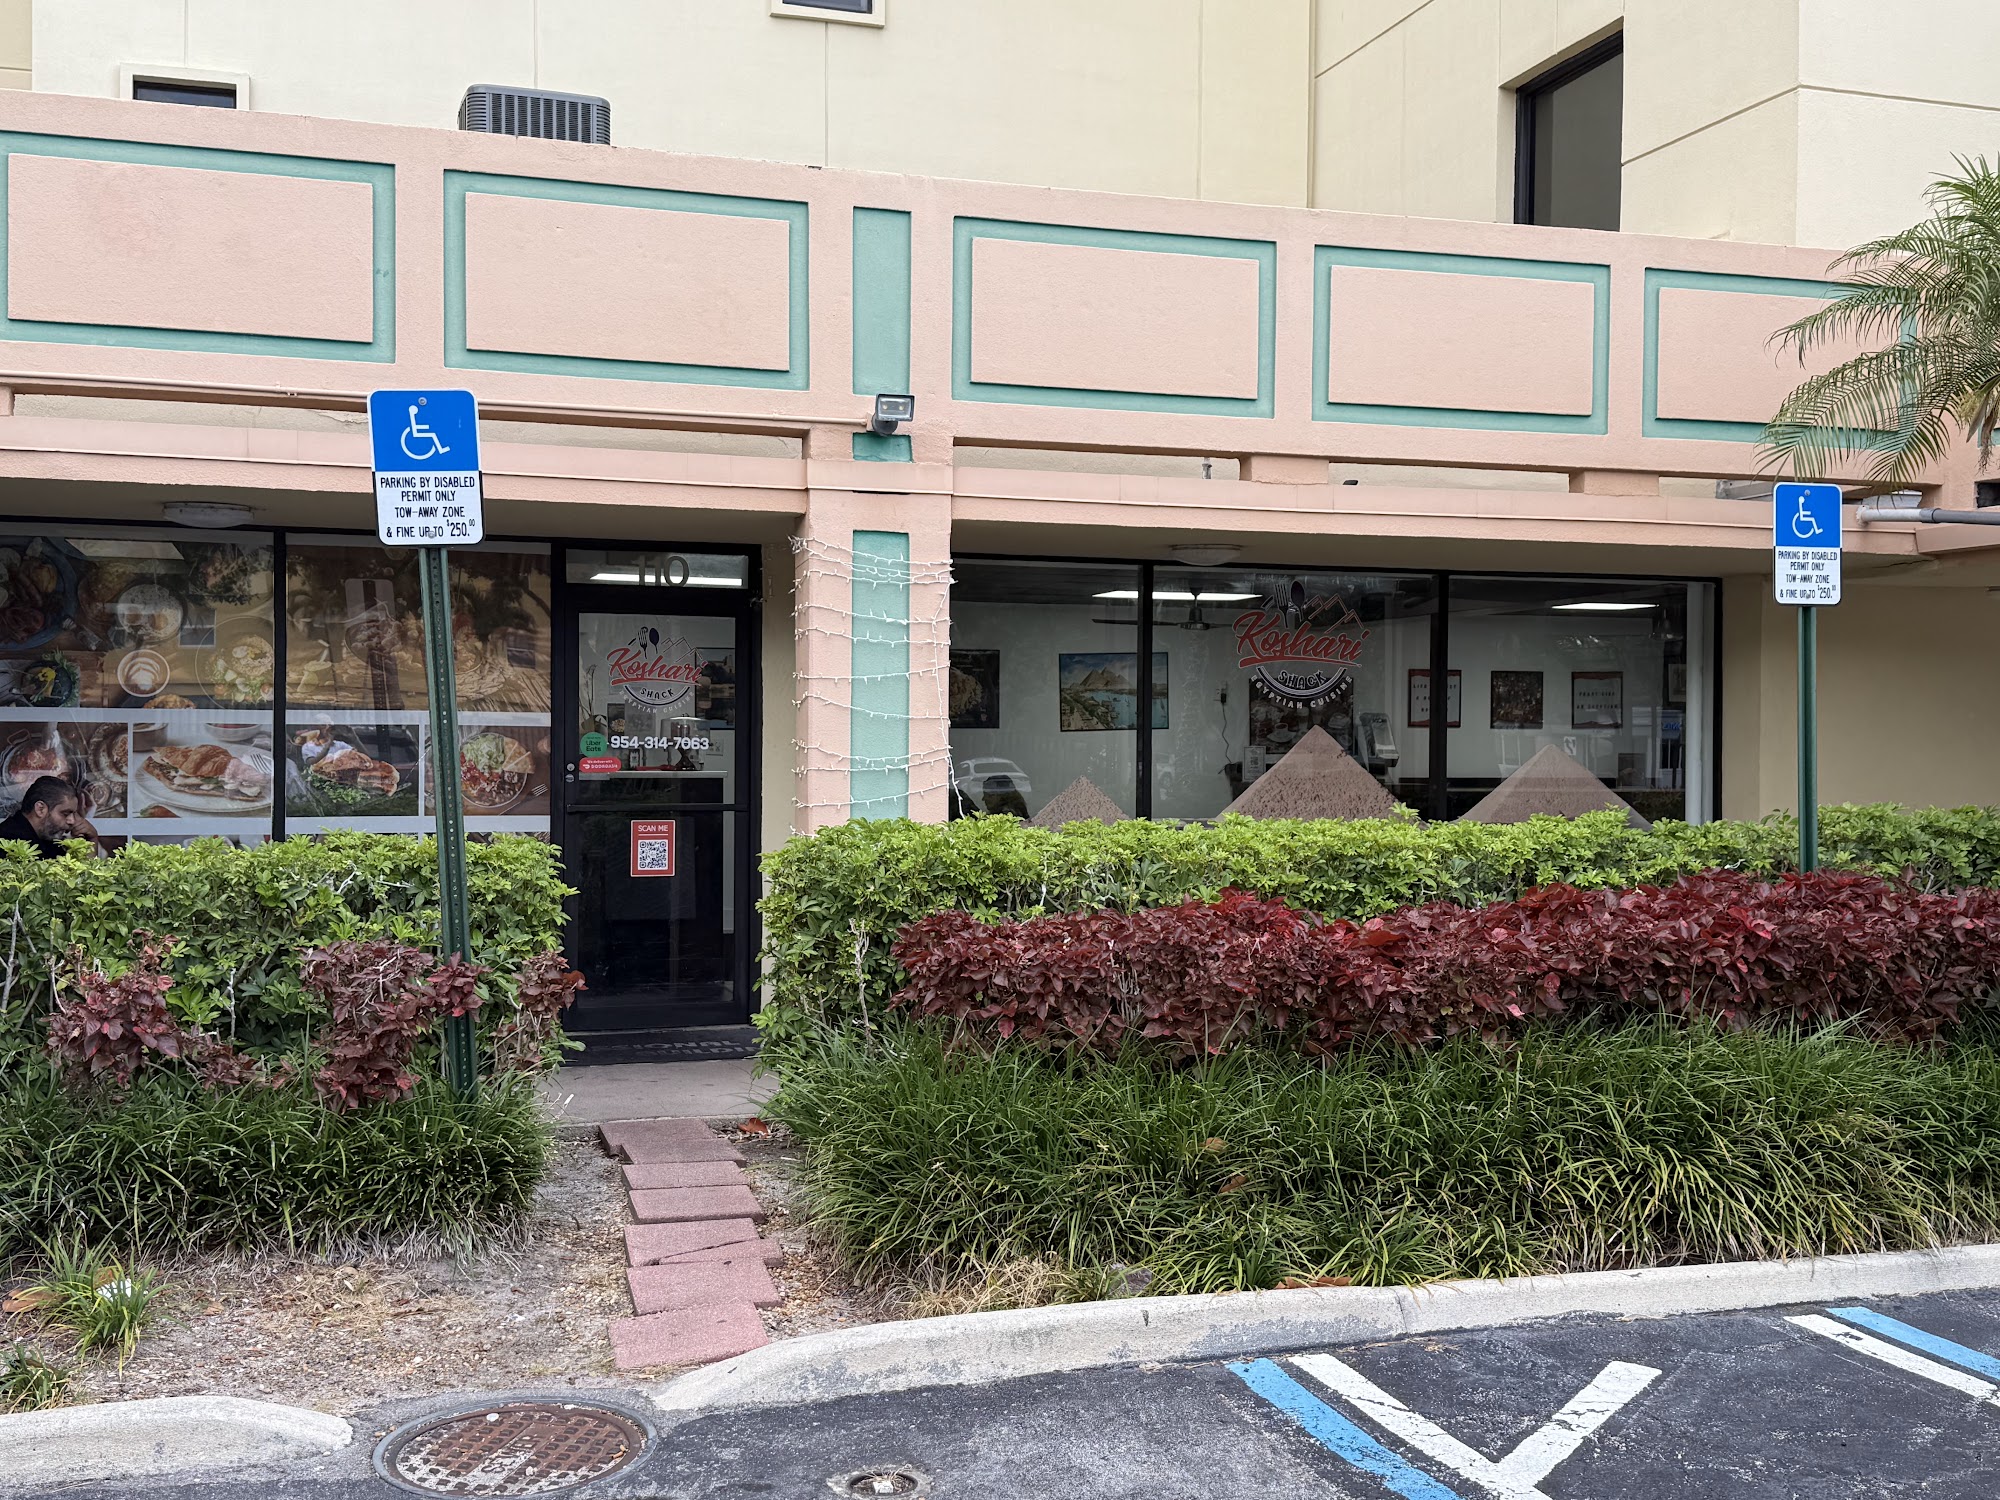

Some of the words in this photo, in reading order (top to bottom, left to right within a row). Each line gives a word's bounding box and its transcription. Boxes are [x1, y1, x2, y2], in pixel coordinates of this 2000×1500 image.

[380, 477, 416, 489] PARKING
[420, 477, 431, 488] BY
[434, 476, 475, 488] DISABLED
[401, 491, 432, 502] PERMIT
[435, 490, 456, 502] ONLY
[395, 507, 439, 518] TOW-AWAY
[442, 506, 465, 518] ZONE
[386, 527, 393, 538] &
[396, 526, 415, 537] FINE
[419, 526, 431, 537] UP
[433, 526, 444, 537] TO
[1778, 550, 1801, 560] PARKING
[1802, 551, 1809, 560] BY
[1811, 551, 1838, 561] DISABLED
[637, 555, 690, 588] 110
[1790, 561, 1809, 571] PERMIT
[1811, 562, 1825, 571] ONLY
[1786, 574, 1813, 583] TOW-AWAY
[1815, 574, 1830, 584] ZONE
[1786, 589, 1797, 598] FINE
[1800, 589, 1807, 598] UP
[1808, 589, 1815, 599] TO
[1232, 611, 1371, 666] Koshari
[606, 647, 709, 685] Koshari
[1277, 670, 1327, 690] SHACK
[639, 687, 675, 700] SHACK
[1250, 675, 1304, 709] EGYPTIAN
[1309, 675, 1354, 709] CUISINE
[610, 735, 710, 750] 954-314-7063
[658, 824, 669, 832] ME
